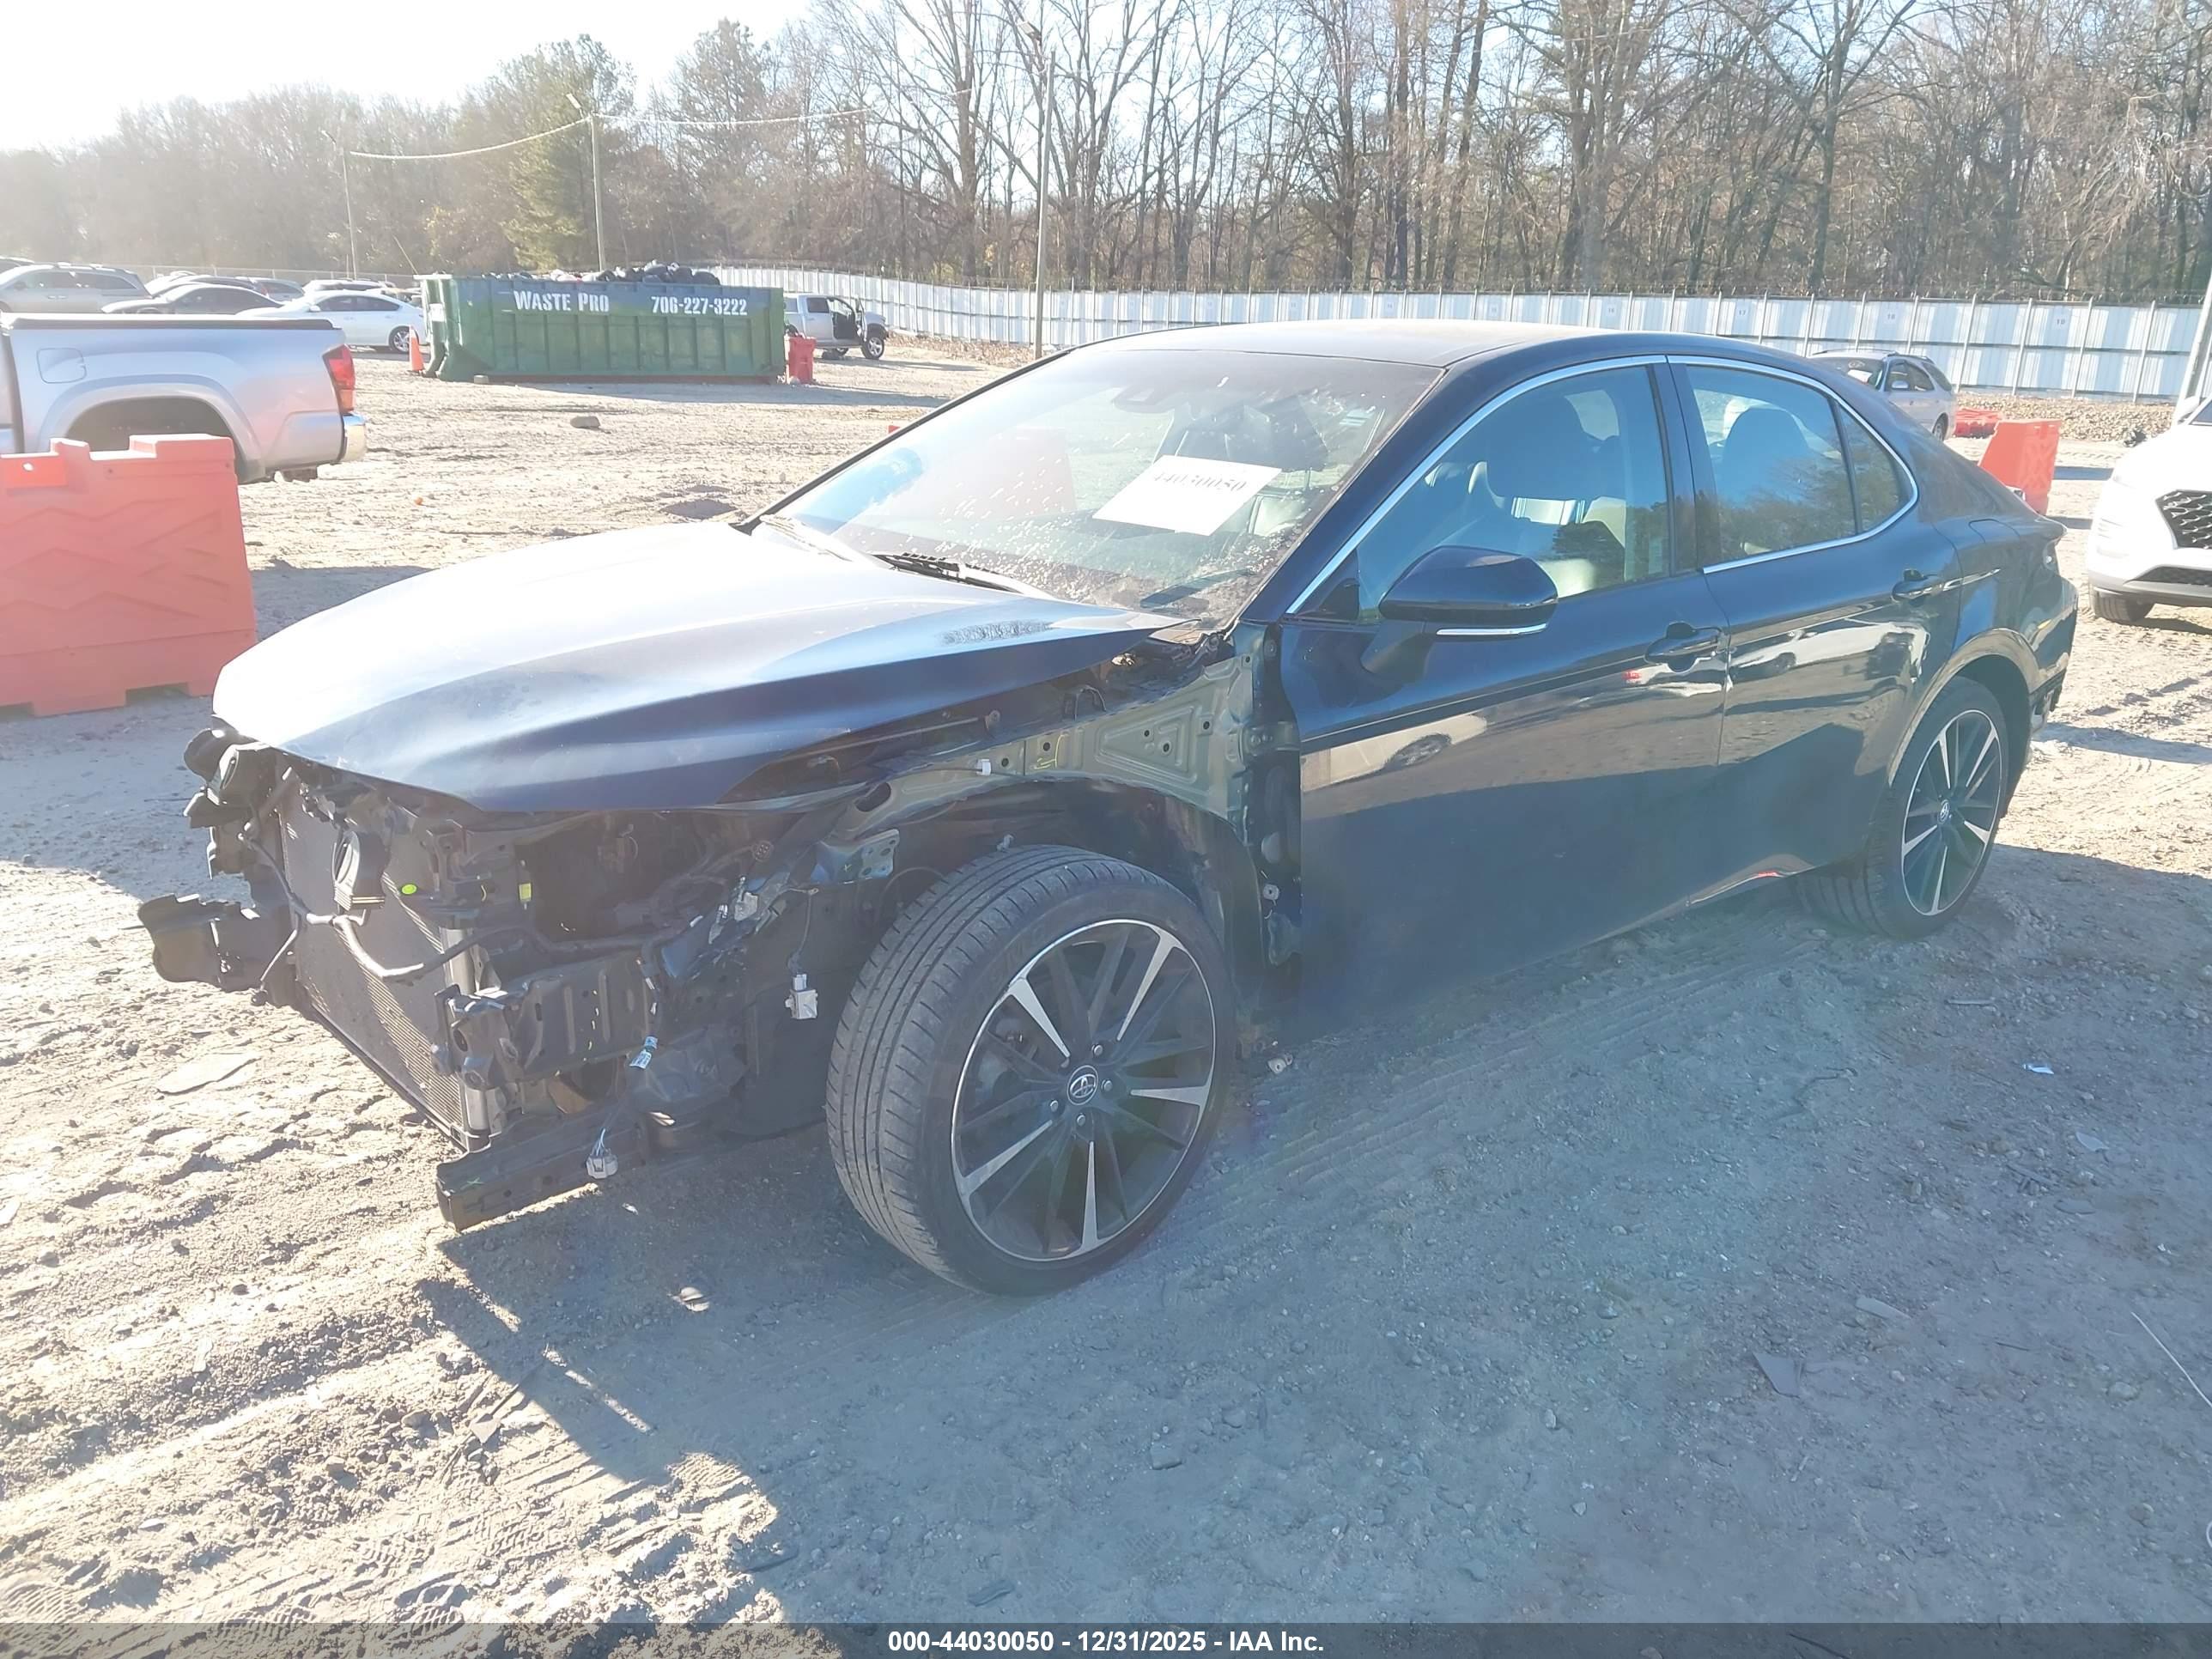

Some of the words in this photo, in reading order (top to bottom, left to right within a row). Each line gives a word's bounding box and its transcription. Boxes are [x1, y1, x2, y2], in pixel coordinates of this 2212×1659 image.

[514, 290, 571, 311] WASTE
[578, 292, 610, 312] PRO
[651, 295, 747, 316] 706-227-3222
